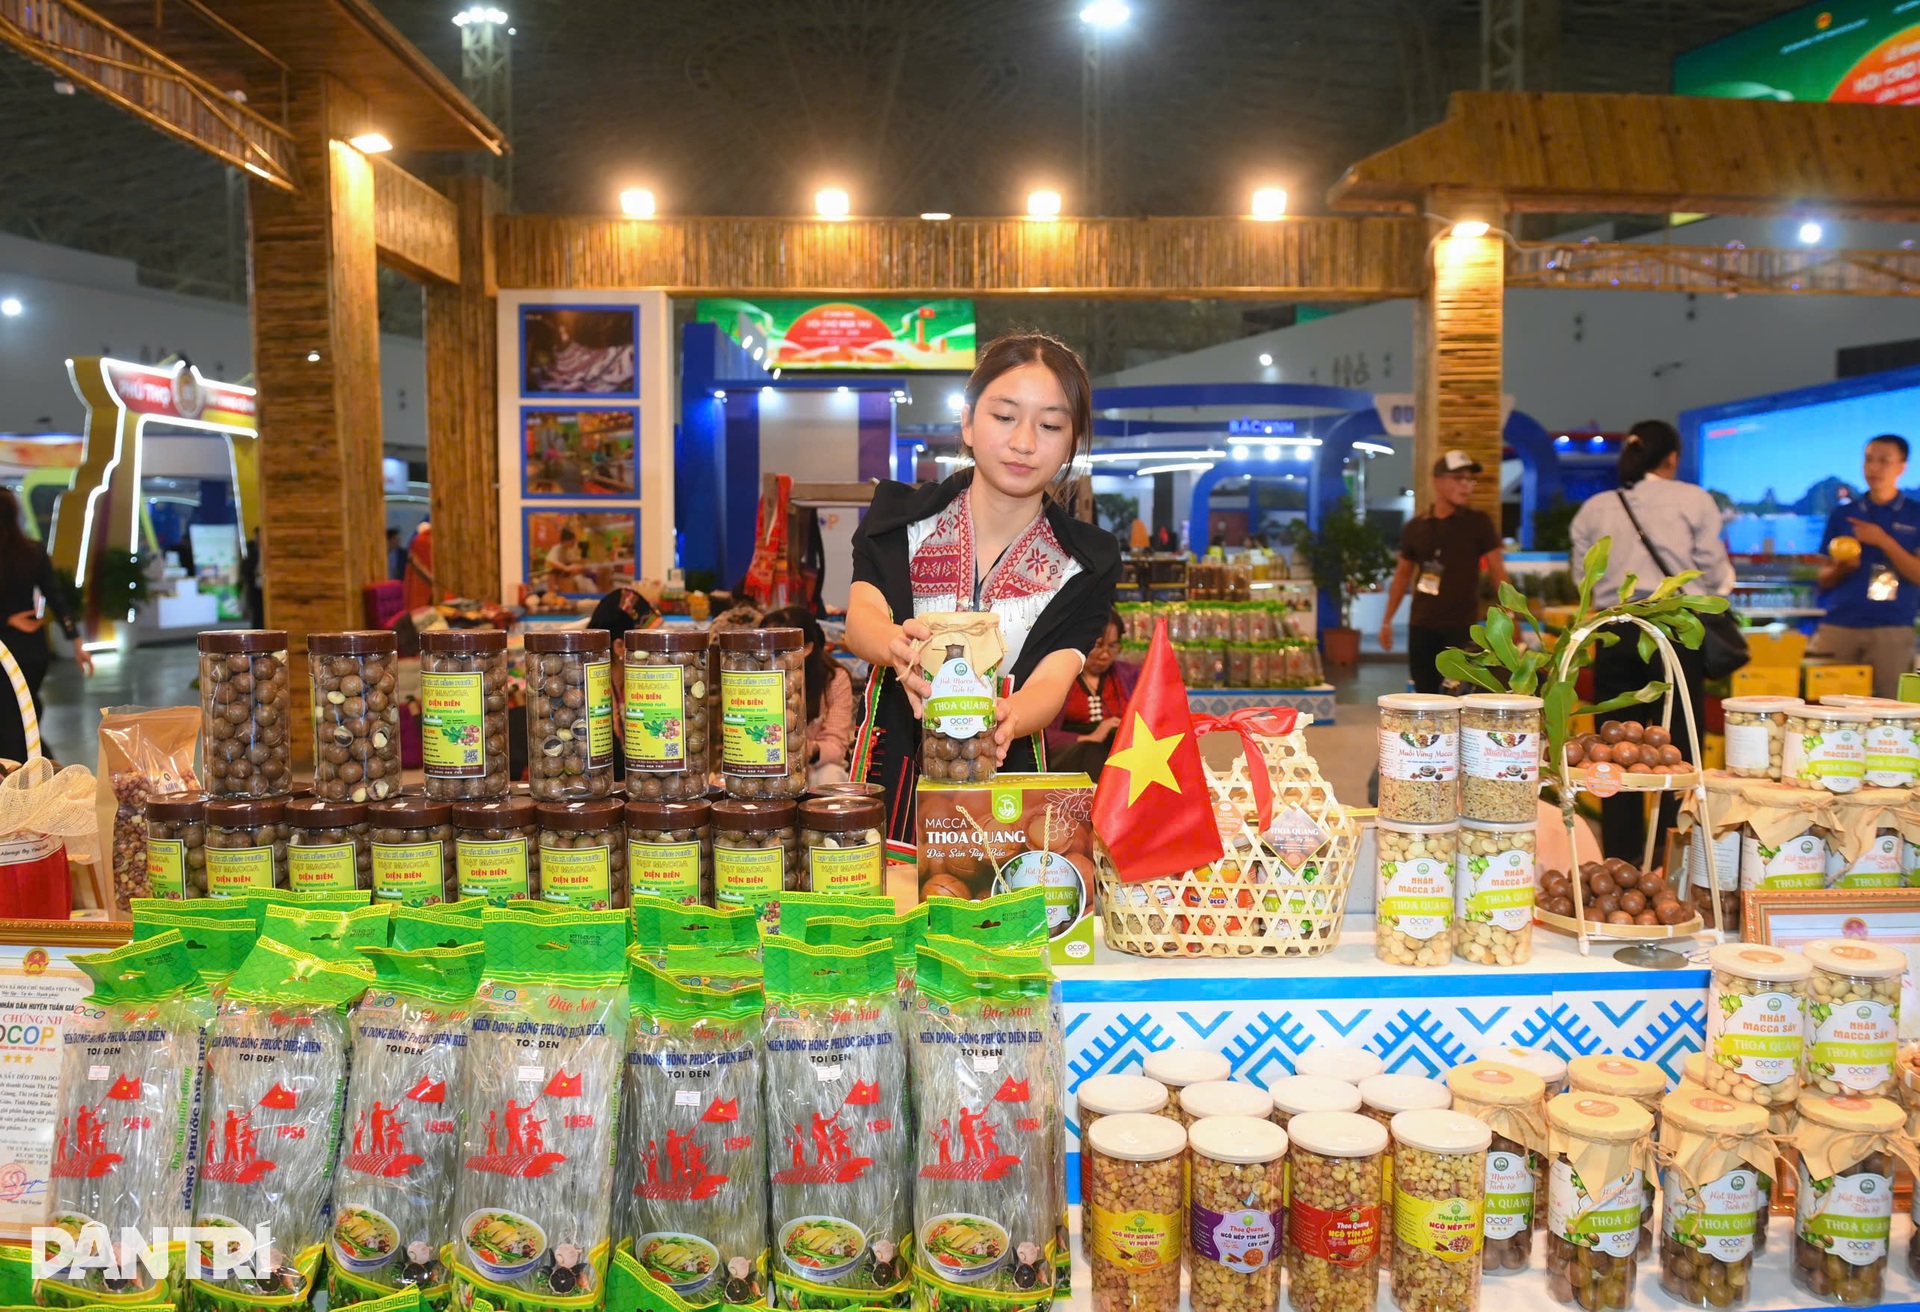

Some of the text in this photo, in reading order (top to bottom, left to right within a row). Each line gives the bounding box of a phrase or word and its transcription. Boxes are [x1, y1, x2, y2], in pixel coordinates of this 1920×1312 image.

[933, 701, 990, 711] THOA QUANG
[950, 717, 974, 725] OCOP
[925, 818, 968, 829] MACCA
[1291, 827, 1319, 836] QUANG
[926, 830, 1027, 845] THOA QUANG
[968, 848, 985, 861] Tây
[1774, 879, 1802, 889] THOA
[479, 985, 528, 1002] OCOP
[546, 993, 573, 1012] Đặc
[15, 1002, 28, 1010] DÂN
[28, 1002, 48, 1011] HUYỆN
[980, 1004, 1033, 1020] Đặc Sản
[3, 1011, 44, 1024] CHỨNG
[857, 1005, 881, 1021] Sản
[1759, 1013, 1786, 1023] NHÂN
[472, 1014, 492, 1031] MIẾN
[491, 1020, 515, 1034] DONG
[515, 1016, 539, 1035] HỒNG
[540, 1022, 568, 1038] PHƯỚC
[586, 1020, 606, 1036] BIÊN
[1743, 1021, 1798, 1034] MACCA SẤY
[1850, 1021, 1877, 1030] NHÂN
[919, 1027, 1043, 1046] MIẾN DONG ĐIỆN BIÊN
[1833, 1029, 1890, 1040] MACCA SẤY
[221, 1037, 240, 1050] DONG
[240, 1032, 259, 1050] HỒNG
[538, 1040, 560, 1049] ĐEN
[785, 1039, 807, 1052] DONG
[808, 1032, 829, 1051] HỒNG
[830, 1036, 856, 1050] PHƯỚC
[876, 1030, 893, 1046] BIÊN
[1733, 1039, 1767, 1051] THOA
[404, 1046, 424, 1056] ĐEN
[665, 1047, 687, 1066] HỒNG
[737, 1048, 754, 1063] BIÊN
[961, 1048, 1003, 1058] TOI ĐEN
[1826, 1047, 1858, 1058] THOA
[256, 1054, 276, 1063] ĐEN
[811, 1053, 852, 1064] TOI ĐEN
[1755, 1058, 1784, 1069] OCOP
[667, 1070, 711, 1079] TOI ĐEN
[1848, 1066, 1878, 1075] OCOP
[424, 1119, 454, 1134] 1954
[563, 1114, 595, 1129] 1954
[866, 1118, 893, 1133] 1954
[276, 1126, 306, 1140] 1954
[723, 1135, 751, 1152] 1954
[179, 1108, 200, 1211] HỒNG PHƯỚC
[1498, 1197, 1530, 1209] QUANG
[1352, 1220, 1370, 1230] Quang
[1485, 1216, 1514, 1225] OCOP
[1589, 1213, 1622, 1227] THOA
[1698, 1218, 1730, 1230] THOA
[1823, 1219, 1859, 1232] THOA
[1246, 1226, 1264, 1234] Quang
[1429, 1221, 1463, 1231] NGÔ NẾP
[1612, 1232, 1636, 1242] OCOP
[1719, 1237, 1745, 1248] OCOP
[1847, 1240, 1876, 1250] OCOP
